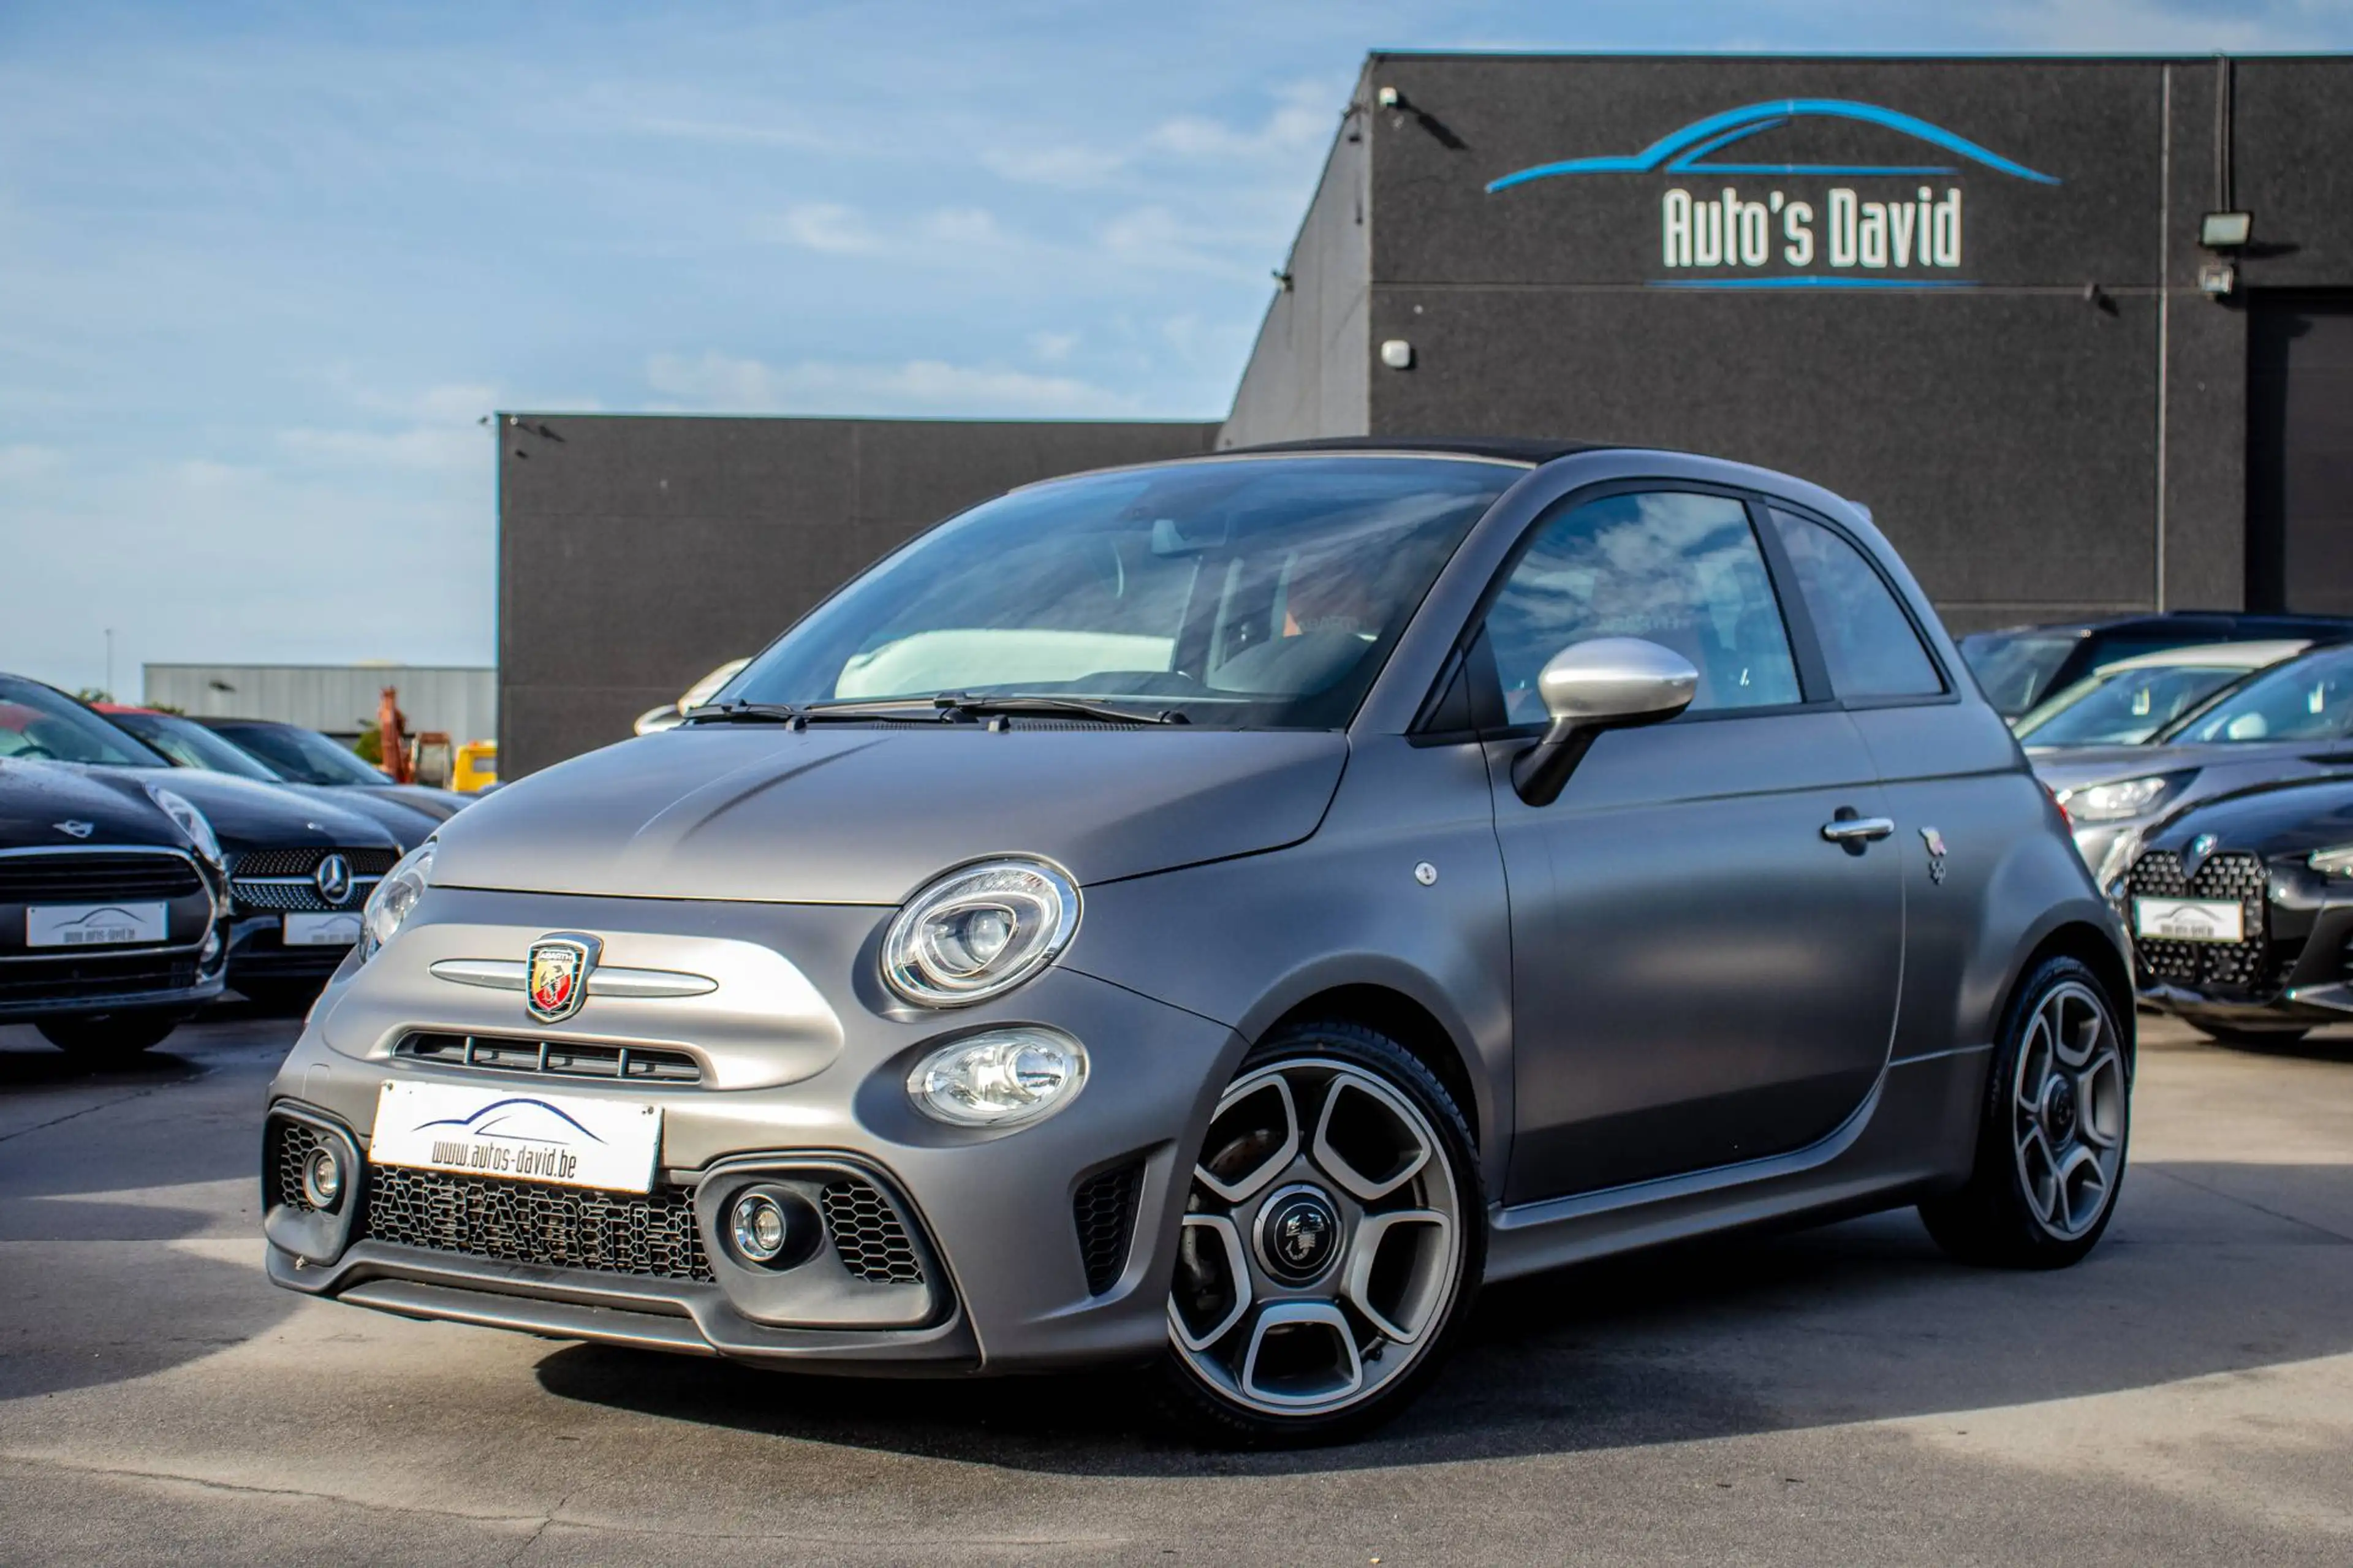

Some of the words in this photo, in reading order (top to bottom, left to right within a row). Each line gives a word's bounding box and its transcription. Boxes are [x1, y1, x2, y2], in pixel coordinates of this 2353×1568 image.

[1662, 186, 1814, 267] Auto's
[1828, 186, 1961, 268] David
[431, 1140, 577, 1179] www.autos-david.be
[374, 1180, 693, 1268] ABARTH
